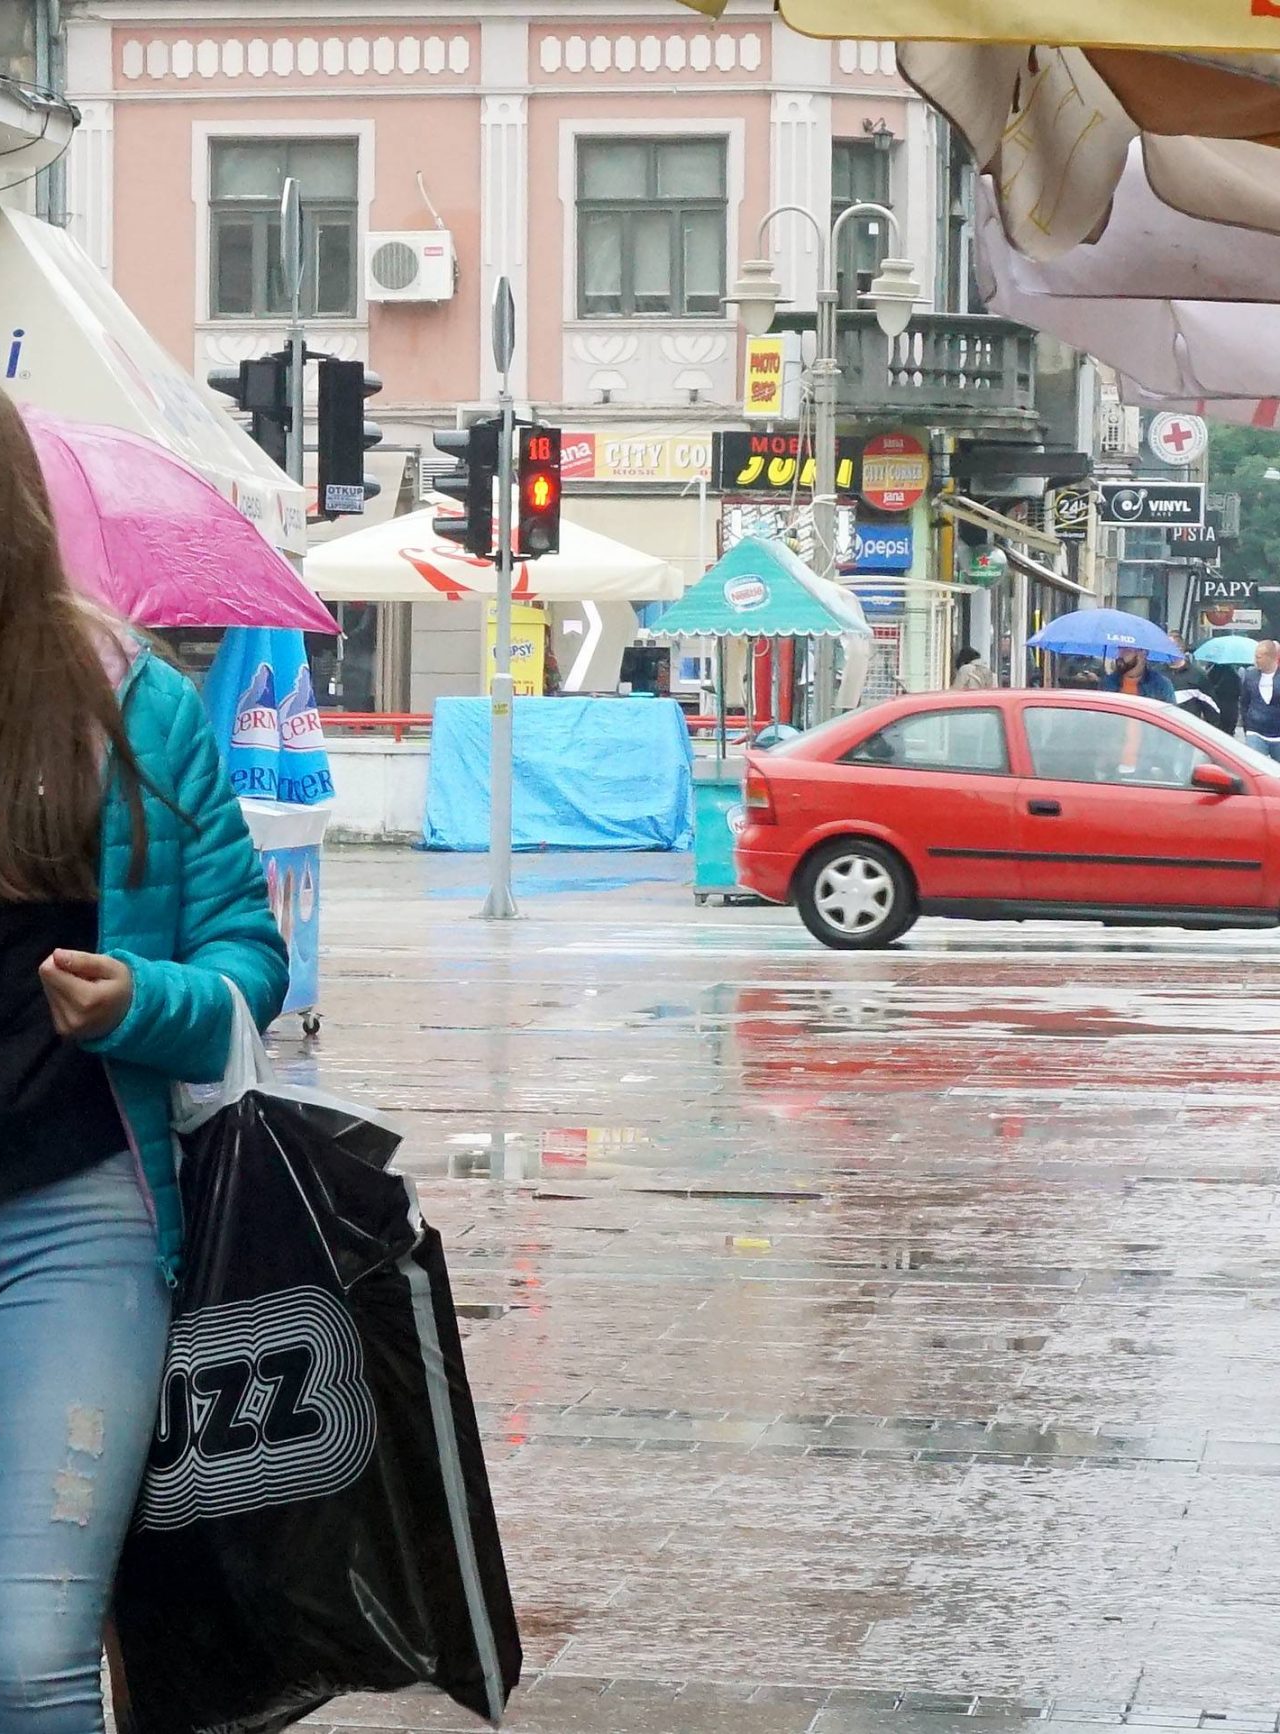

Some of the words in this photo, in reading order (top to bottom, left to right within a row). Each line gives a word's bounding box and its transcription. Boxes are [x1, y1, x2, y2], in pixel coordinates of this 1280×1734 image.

[751, 353, 780, 373] PHOTO
[751, 381, 776, 402] SHOP
[528, 437, 551, 460] 18
[561, 442, 592, 463] ana
[604, 442, 664, 469] CITY
[327, 486, 363, 496] OTKUP
[1148, 500, 1192, 512] VINYL
[1172, 526, 1216, 542] PISTA
[864, 537, 909, 558] pepsi
[1204, 581, 1255, 597] PAPY
